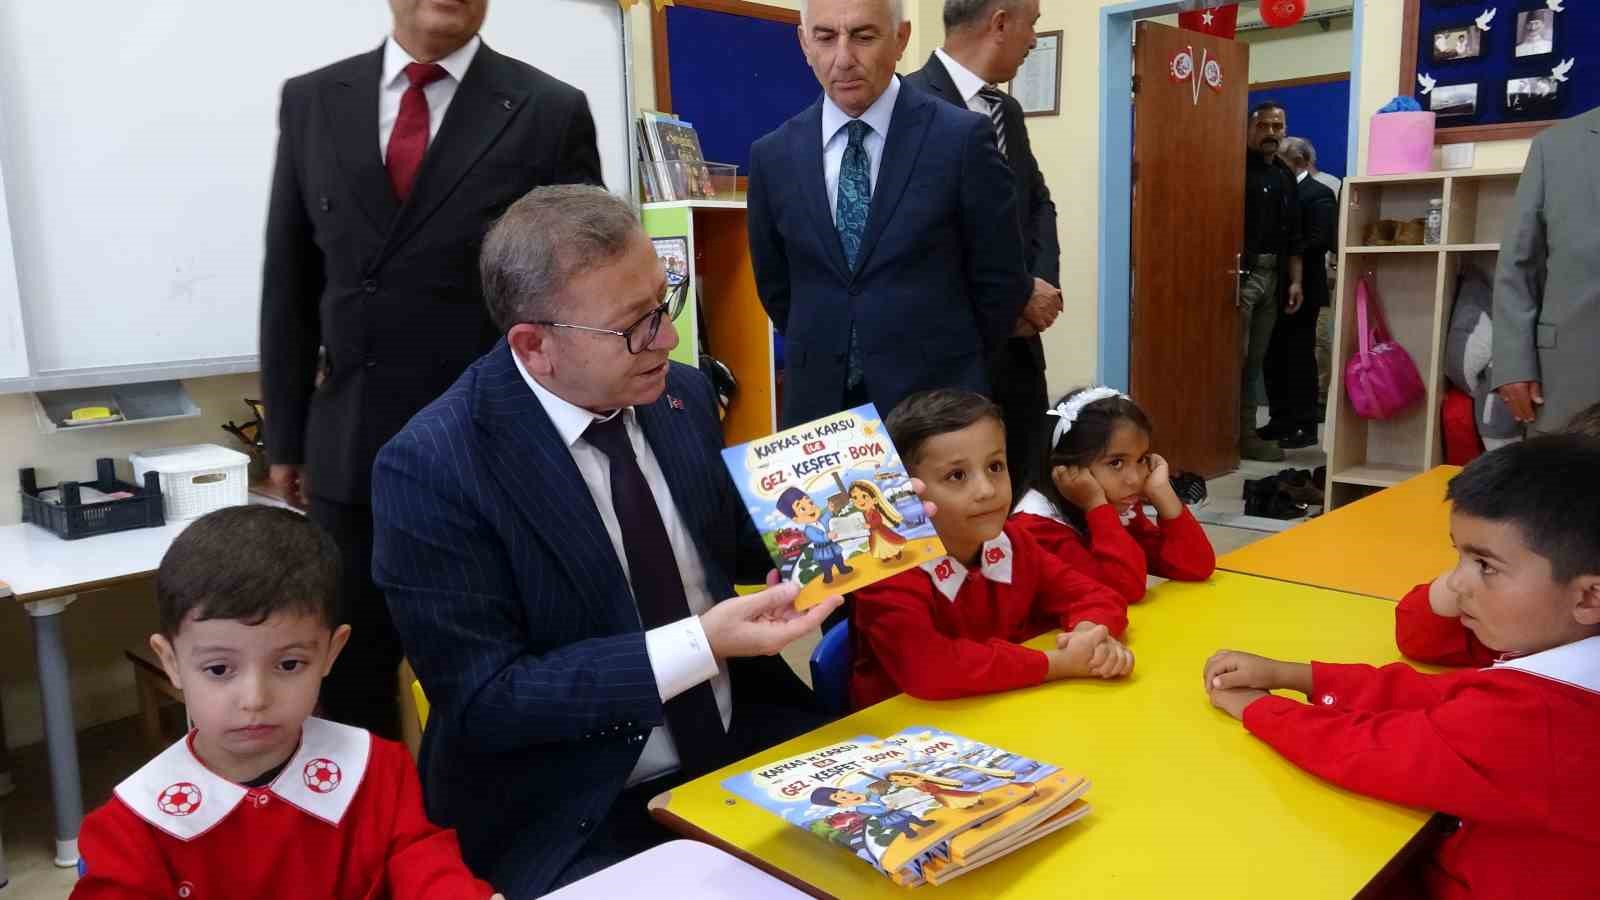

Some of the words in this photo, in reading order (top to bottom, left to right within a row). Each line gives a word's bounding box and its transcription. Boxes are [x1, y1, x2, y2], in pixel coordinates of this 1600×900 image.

[754, 435, 799, 459] KAFKAS
[815, 418, 855, 437] KARSU
[761, 470, 787, 491] GEZ
[792, 452, 840, 477] KEŞFET
[849, 442, 885, 459] BOYA
[758, 759, 806, 778] KAFKAS
[921, 741, 953, 755] OYA
[781, 780, 810, 796] GEZ
[809, 761, 862, 782] KEŞFET
[864, 750, 904, 762] BOYA
